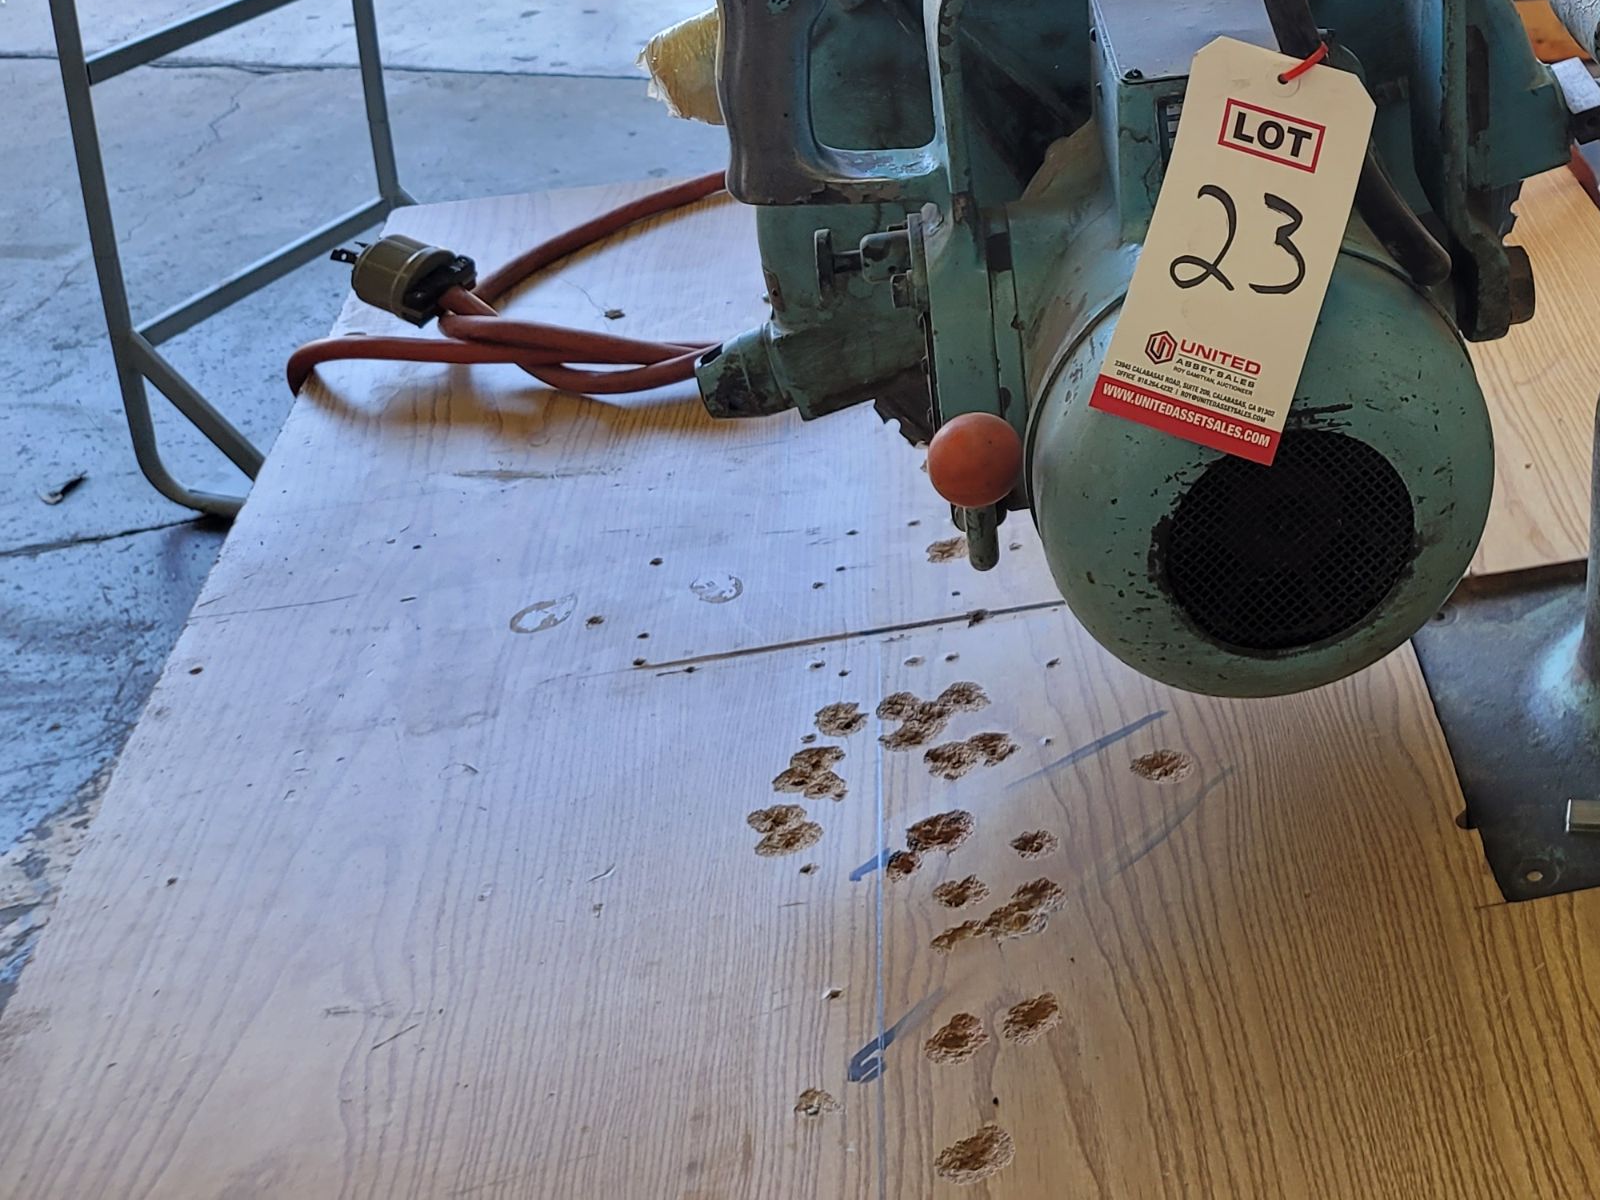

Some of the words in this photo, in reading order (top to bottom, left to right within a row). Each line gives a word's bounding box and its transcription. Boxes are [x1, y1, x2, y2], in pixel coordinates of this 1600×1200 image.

[1198, 111, 1312, 158] LOT
[1170, 184, 1306, 295] 23
[1116, 369, 1136, 381] OFFICE
[1132, 365, 1165, 381] CALABASAS
[1176, 358, 1214, 375] ASSET
[1217, 371, 1256, 389] SALES
[1180, 339, 1263, 376] UNITED
[1103, 382, 1271, 448] WWW.UNITEDASSETSALES.COM
